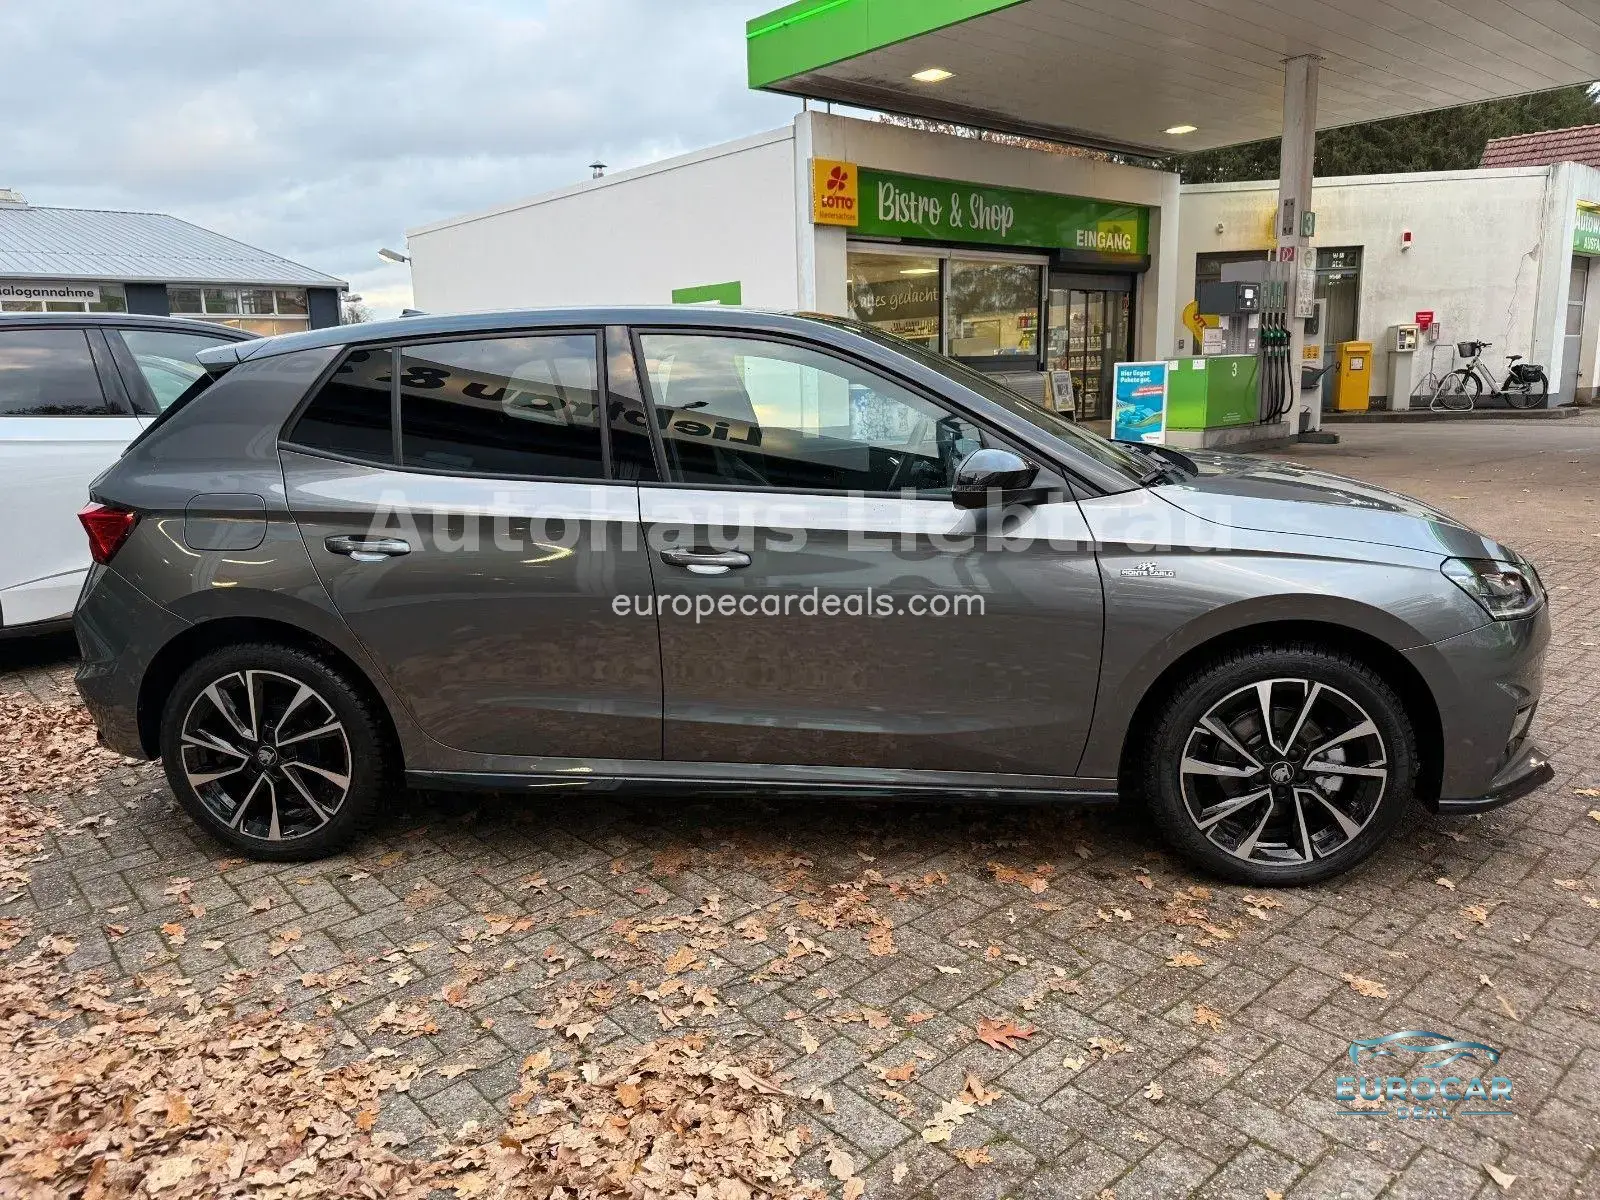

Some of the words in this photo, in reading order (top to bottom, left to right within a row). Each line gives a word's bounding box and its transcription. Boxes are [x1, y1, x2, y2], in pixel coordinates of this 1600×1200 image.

[821, 195, 855, 210] LOTTO
[878, 181, 943, 225] Bistro
[949, 192, 963, 227] &
[969, 193, 1014, 238] Shop
[1305, 212, 1313, 235] 3
[1076, 229, 1131, 250] EINGANG
[889, 287, 938, 310] gedacht
[1231, 362, 1238, 376] 3
[1149, 570, 1175, 578] CARLO
